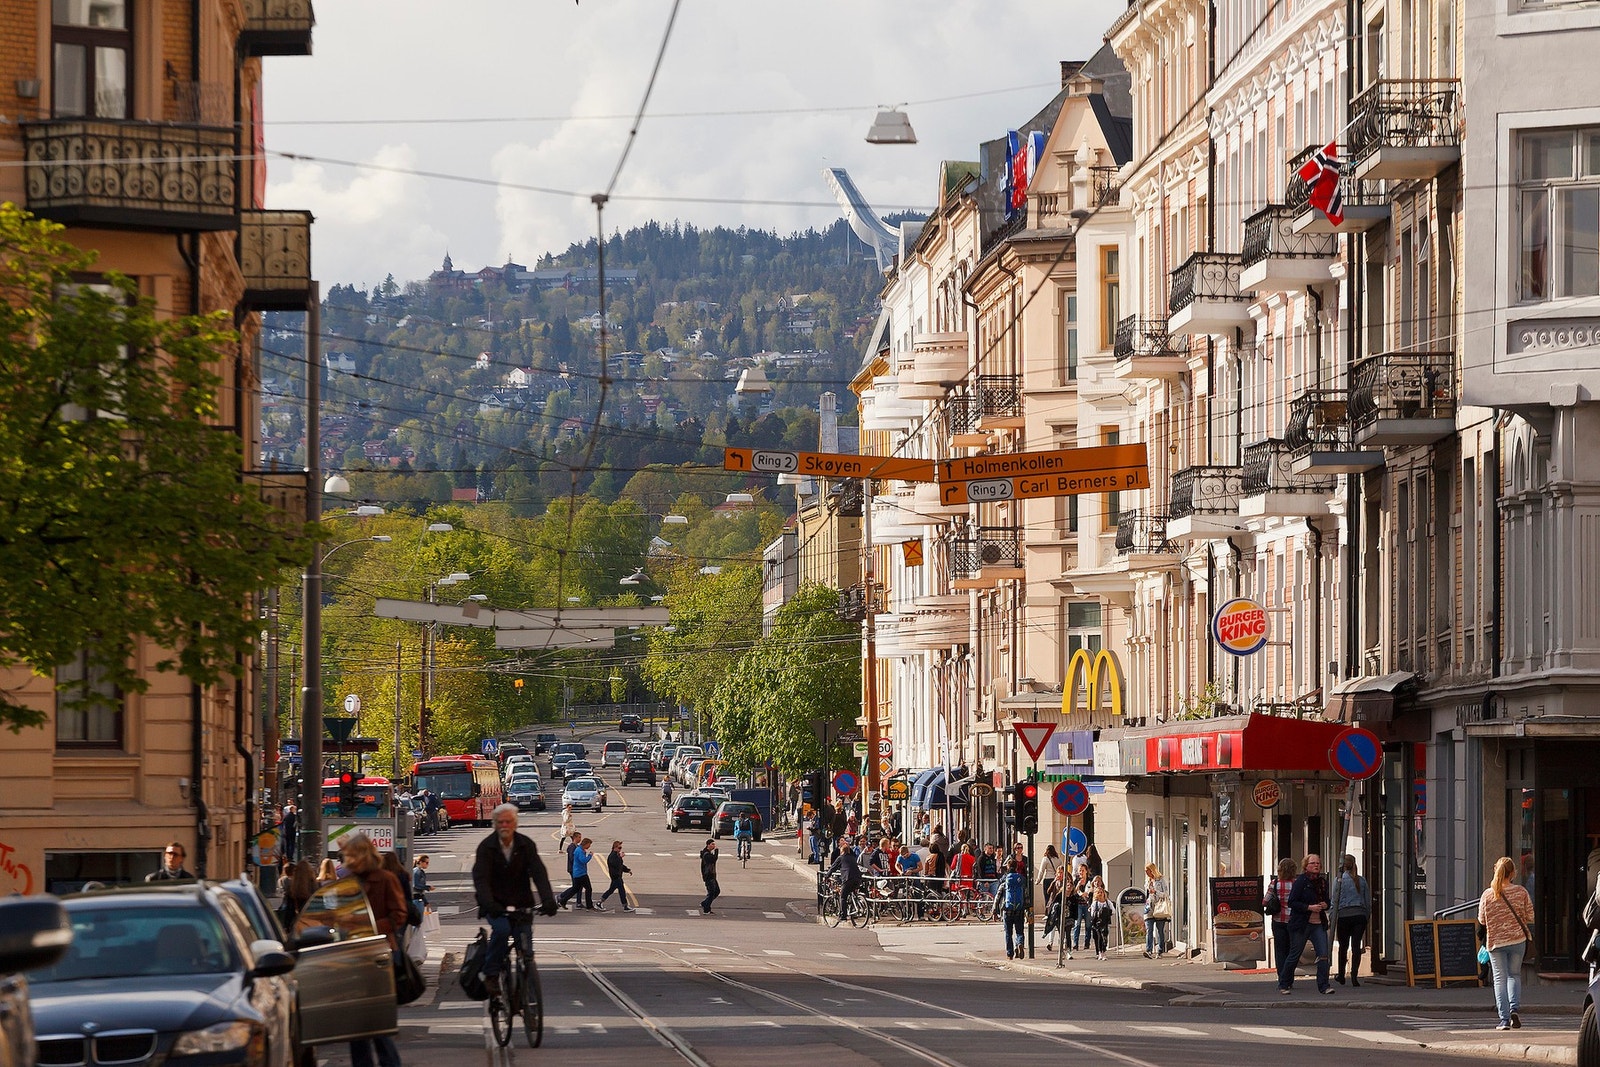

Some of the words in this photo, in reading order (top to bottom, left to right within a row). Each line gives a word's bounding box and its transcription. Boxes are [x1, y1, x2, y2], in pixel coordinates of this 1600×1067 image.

[758, 454, 781, 468] Ring
[784, 456, 792, 468] 2
[805, 456, 861, 475] Skøyen
[964, 455, 1063, 475] Holmenkollen
[973, 482, 996, 496] Ring
[1000, 484, 1007, 495] 2
[1020, 478, 1049, 494] Carl
[1058, 474, 1117, 491] Berners
[1126, 471, 1142, 488] pl.
[1219, 609, 1264, 629] BURGER
[1220, 620, 1266, 643] KING
[879, 742, 891, 753] 50
[1255, 784, 1278, 796] BURGER
[1255, 790, 1279, 804] KING
[374, 828, 392, 837] FOR
[372, 839, 392, 848] ACH
